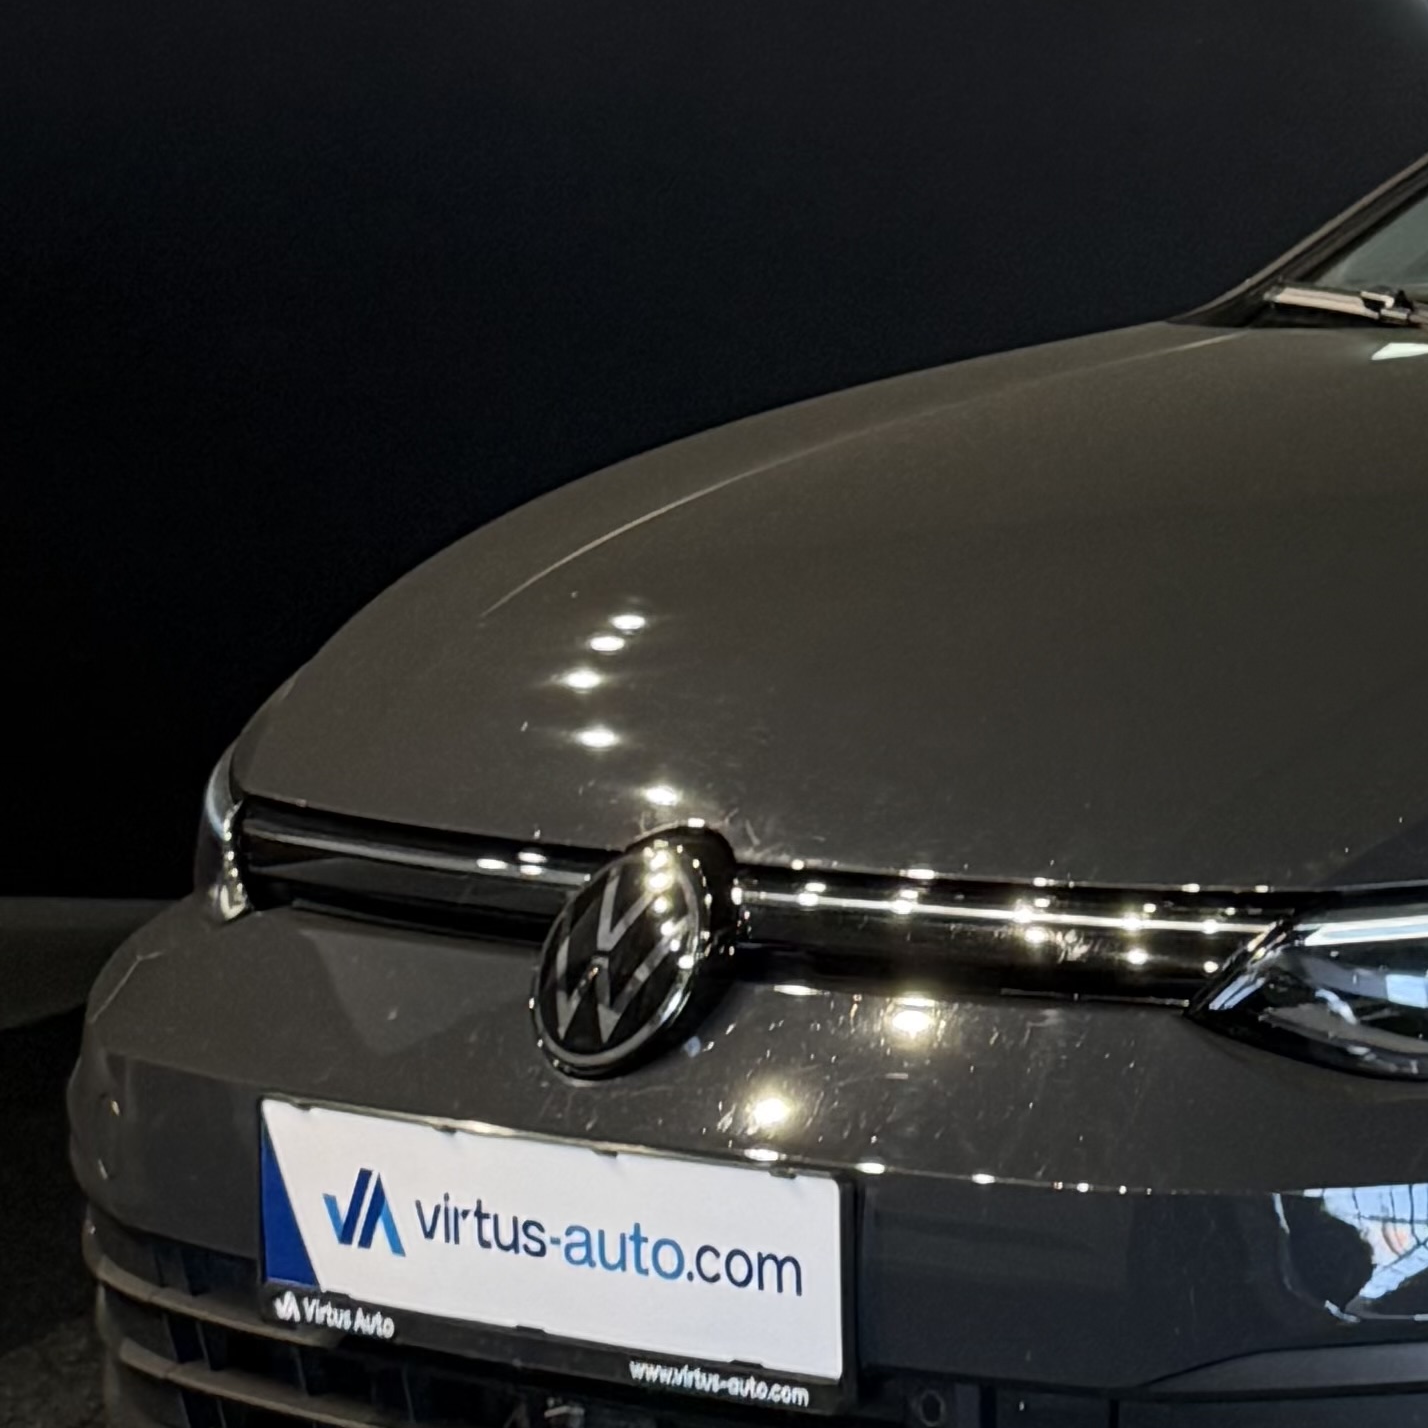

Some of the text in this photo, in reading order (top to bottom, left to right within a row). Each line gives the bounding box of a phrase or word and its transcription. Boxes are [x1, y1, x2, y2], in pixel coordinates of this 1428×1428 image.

[415, 1193, 804, 1297] virtus-auto.com
[303, 1296, 352, 1331] Virtus
[353, 1307, 396, 1339] Auto
[629, 1359, 811, 1408] www.virtus-auto.com
